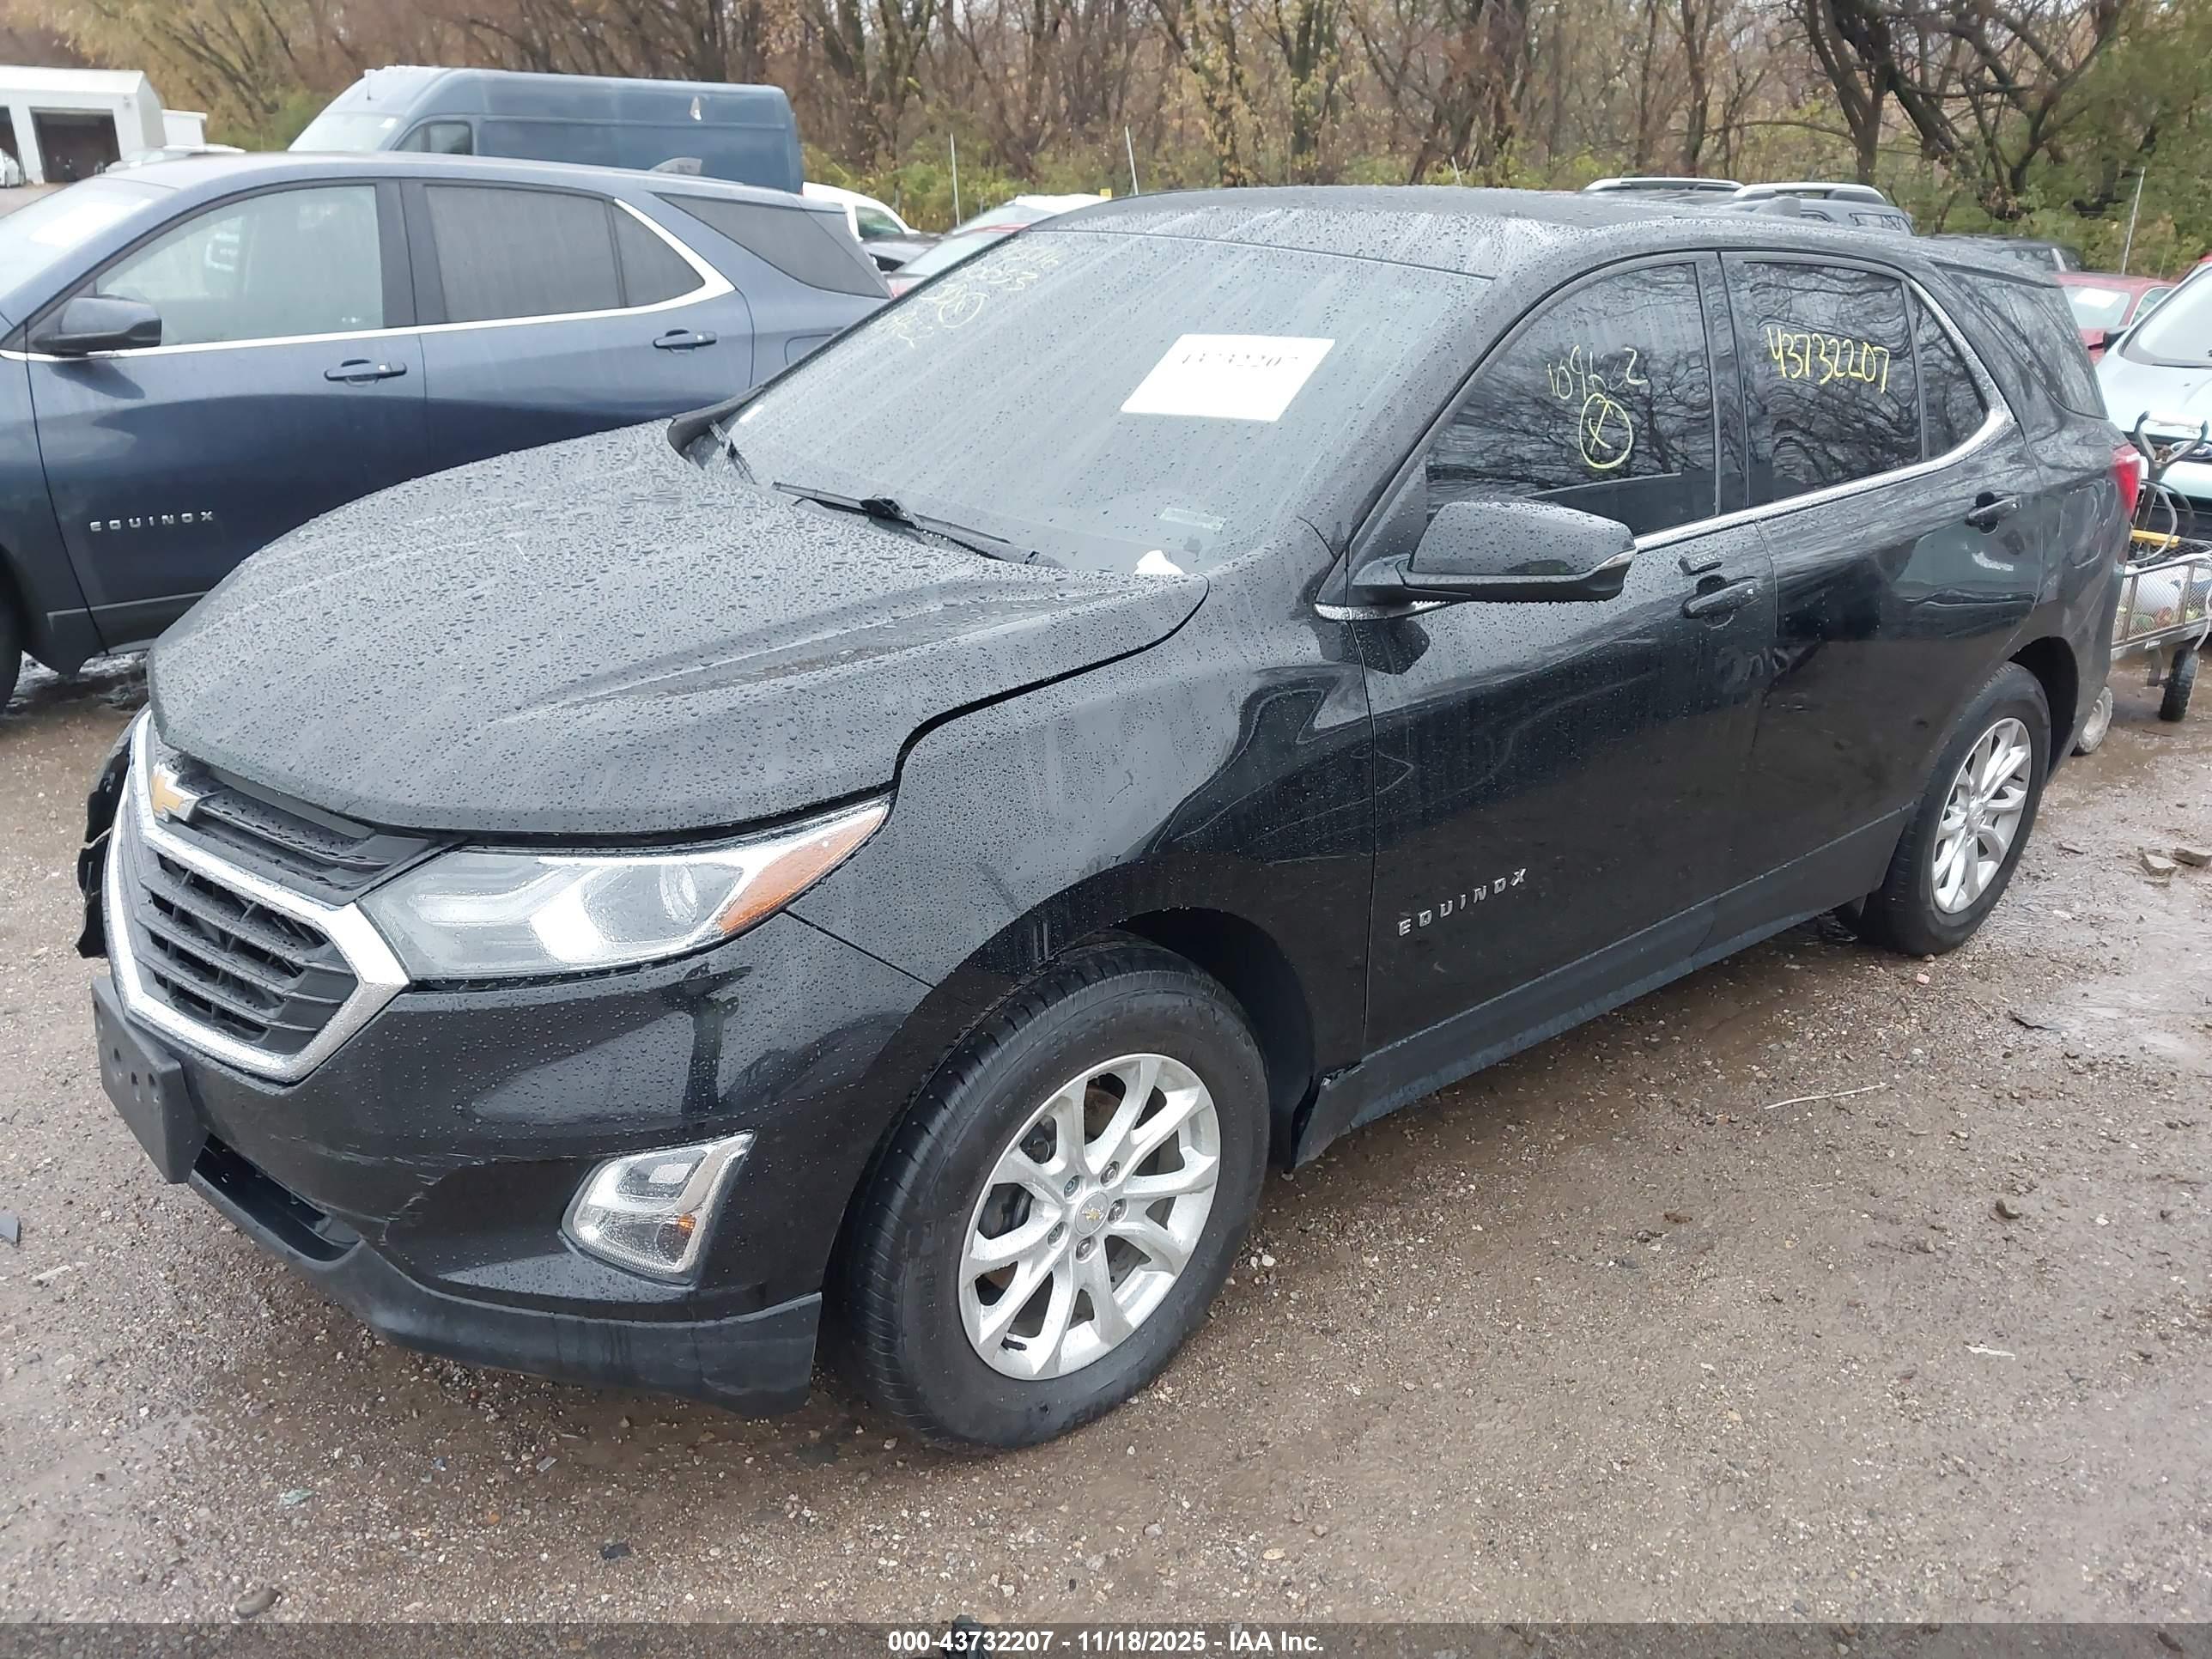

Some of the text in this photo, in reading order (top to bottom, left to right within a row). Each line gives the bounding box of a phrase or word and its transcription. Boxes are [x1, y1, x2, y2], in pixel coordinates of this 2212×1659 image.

[1766, 326, 1890, 395] 43732207
[89, 510, 214, 532] EQUINOX
[1397, 867, 1528, 936] EQUINOX
